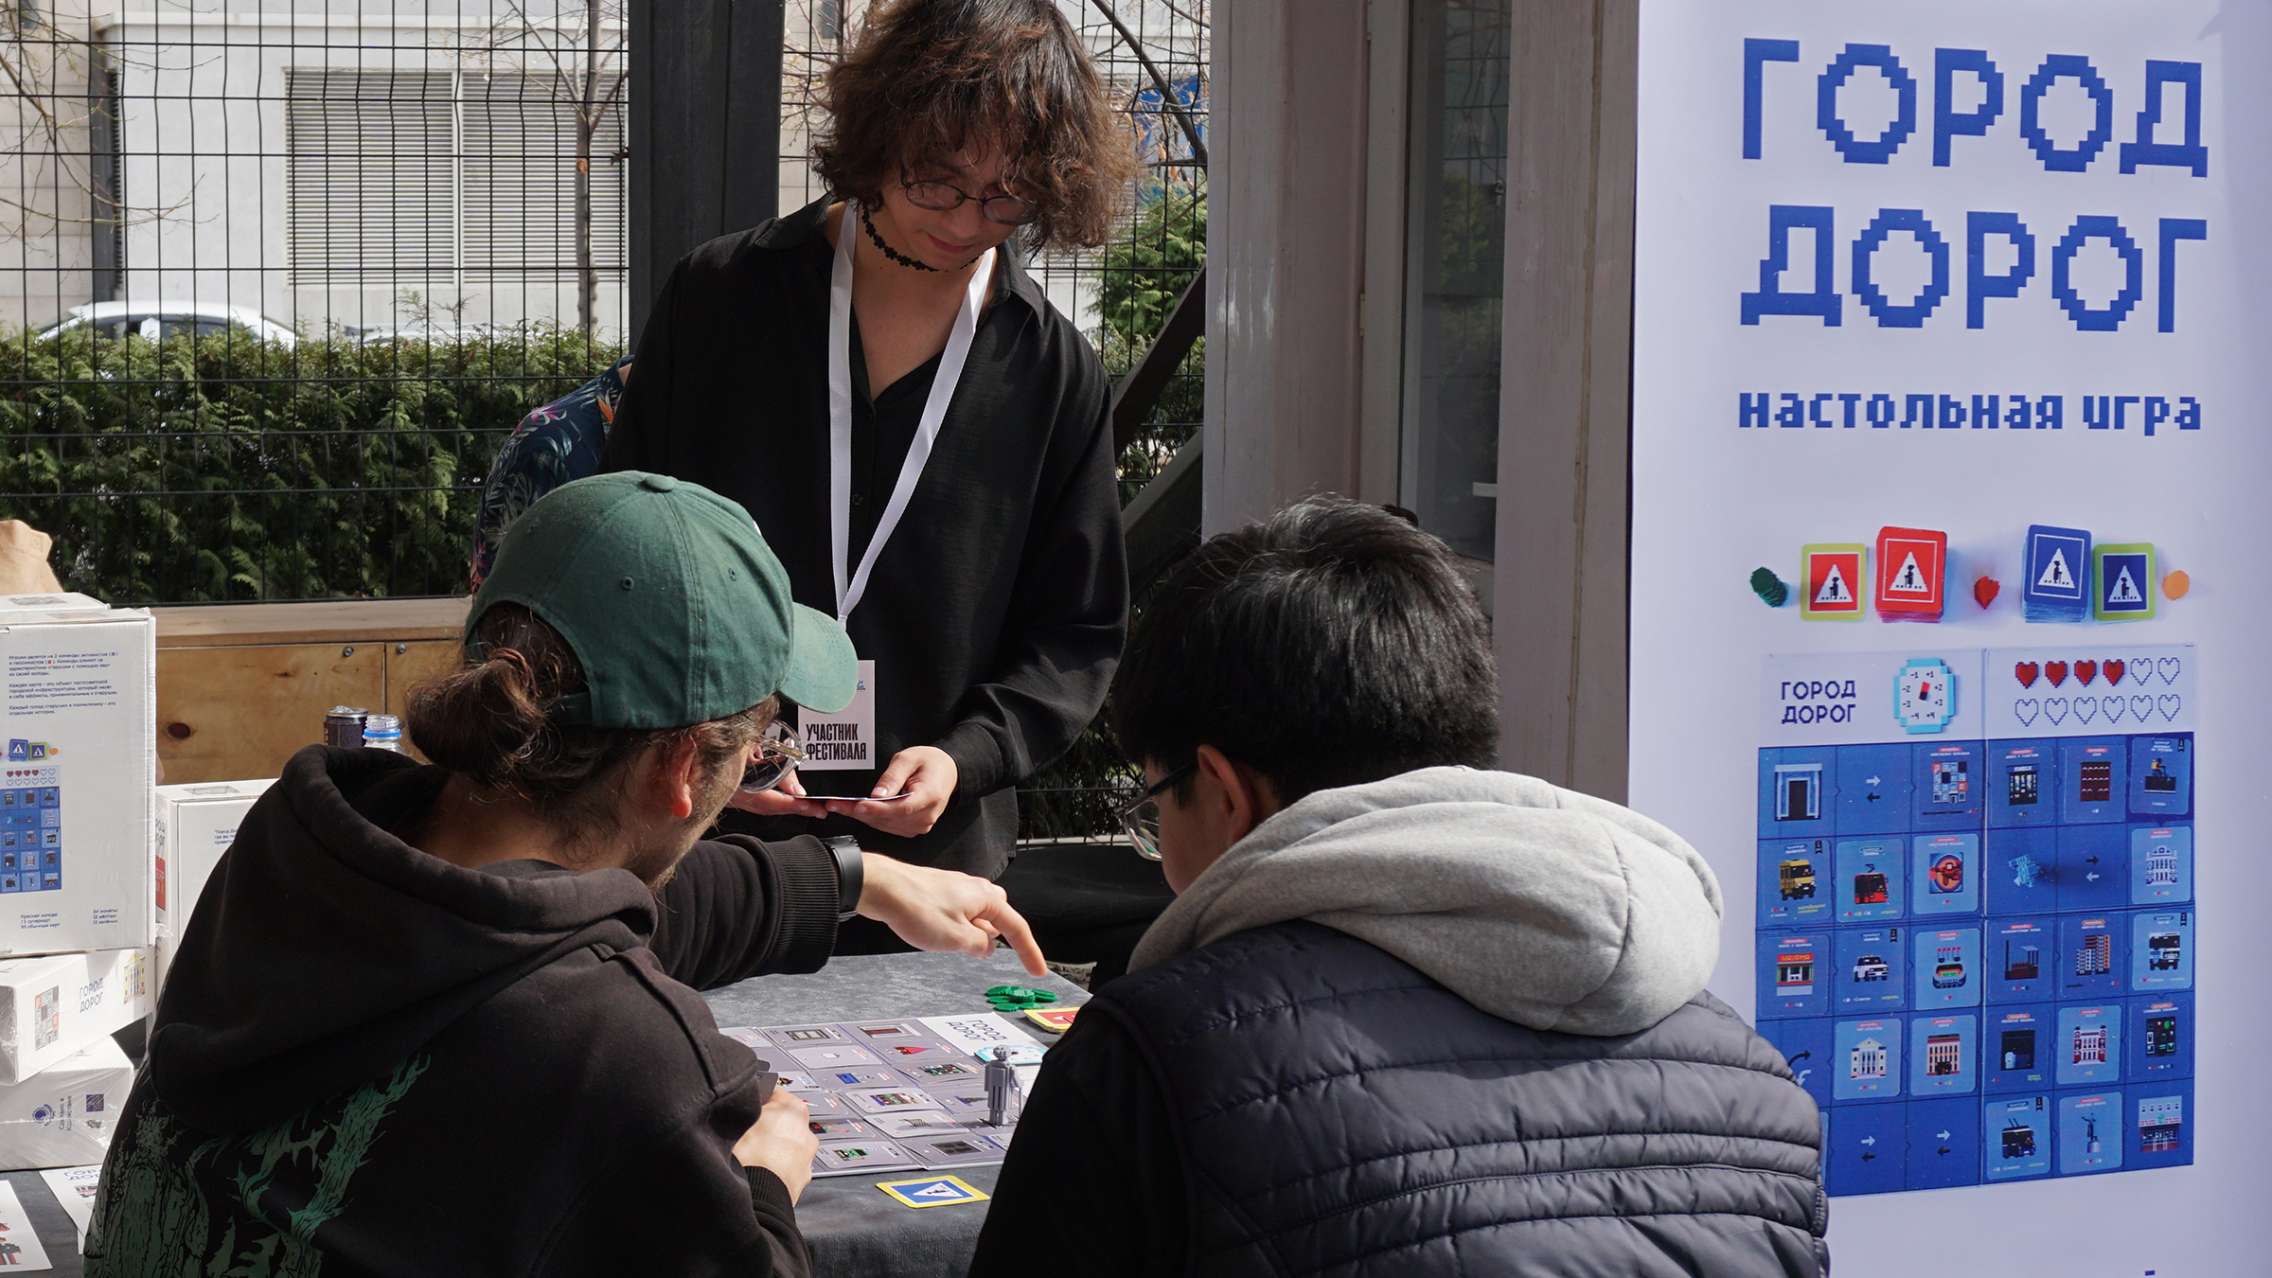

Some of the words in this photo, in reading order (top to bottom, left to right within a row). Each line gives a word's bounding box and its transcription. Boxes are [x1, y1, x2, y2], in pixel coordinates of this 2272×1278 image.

[1743, 37, 2208, 178] ГОРОД
[1740, 204, 2208, 334] ДОРОГ
[1738, 391, 2064, 430] настольная
[2082, 394, 2202, 437] игра
[1781, 680, 1856, 700] ГОРОД
[1781, 704, 1856, 724] ДОРОГ
[805, 723, 859, 741] УЧАСТНИК
[805, 742, 867, 760] ФЕСТИВАЛЯ
